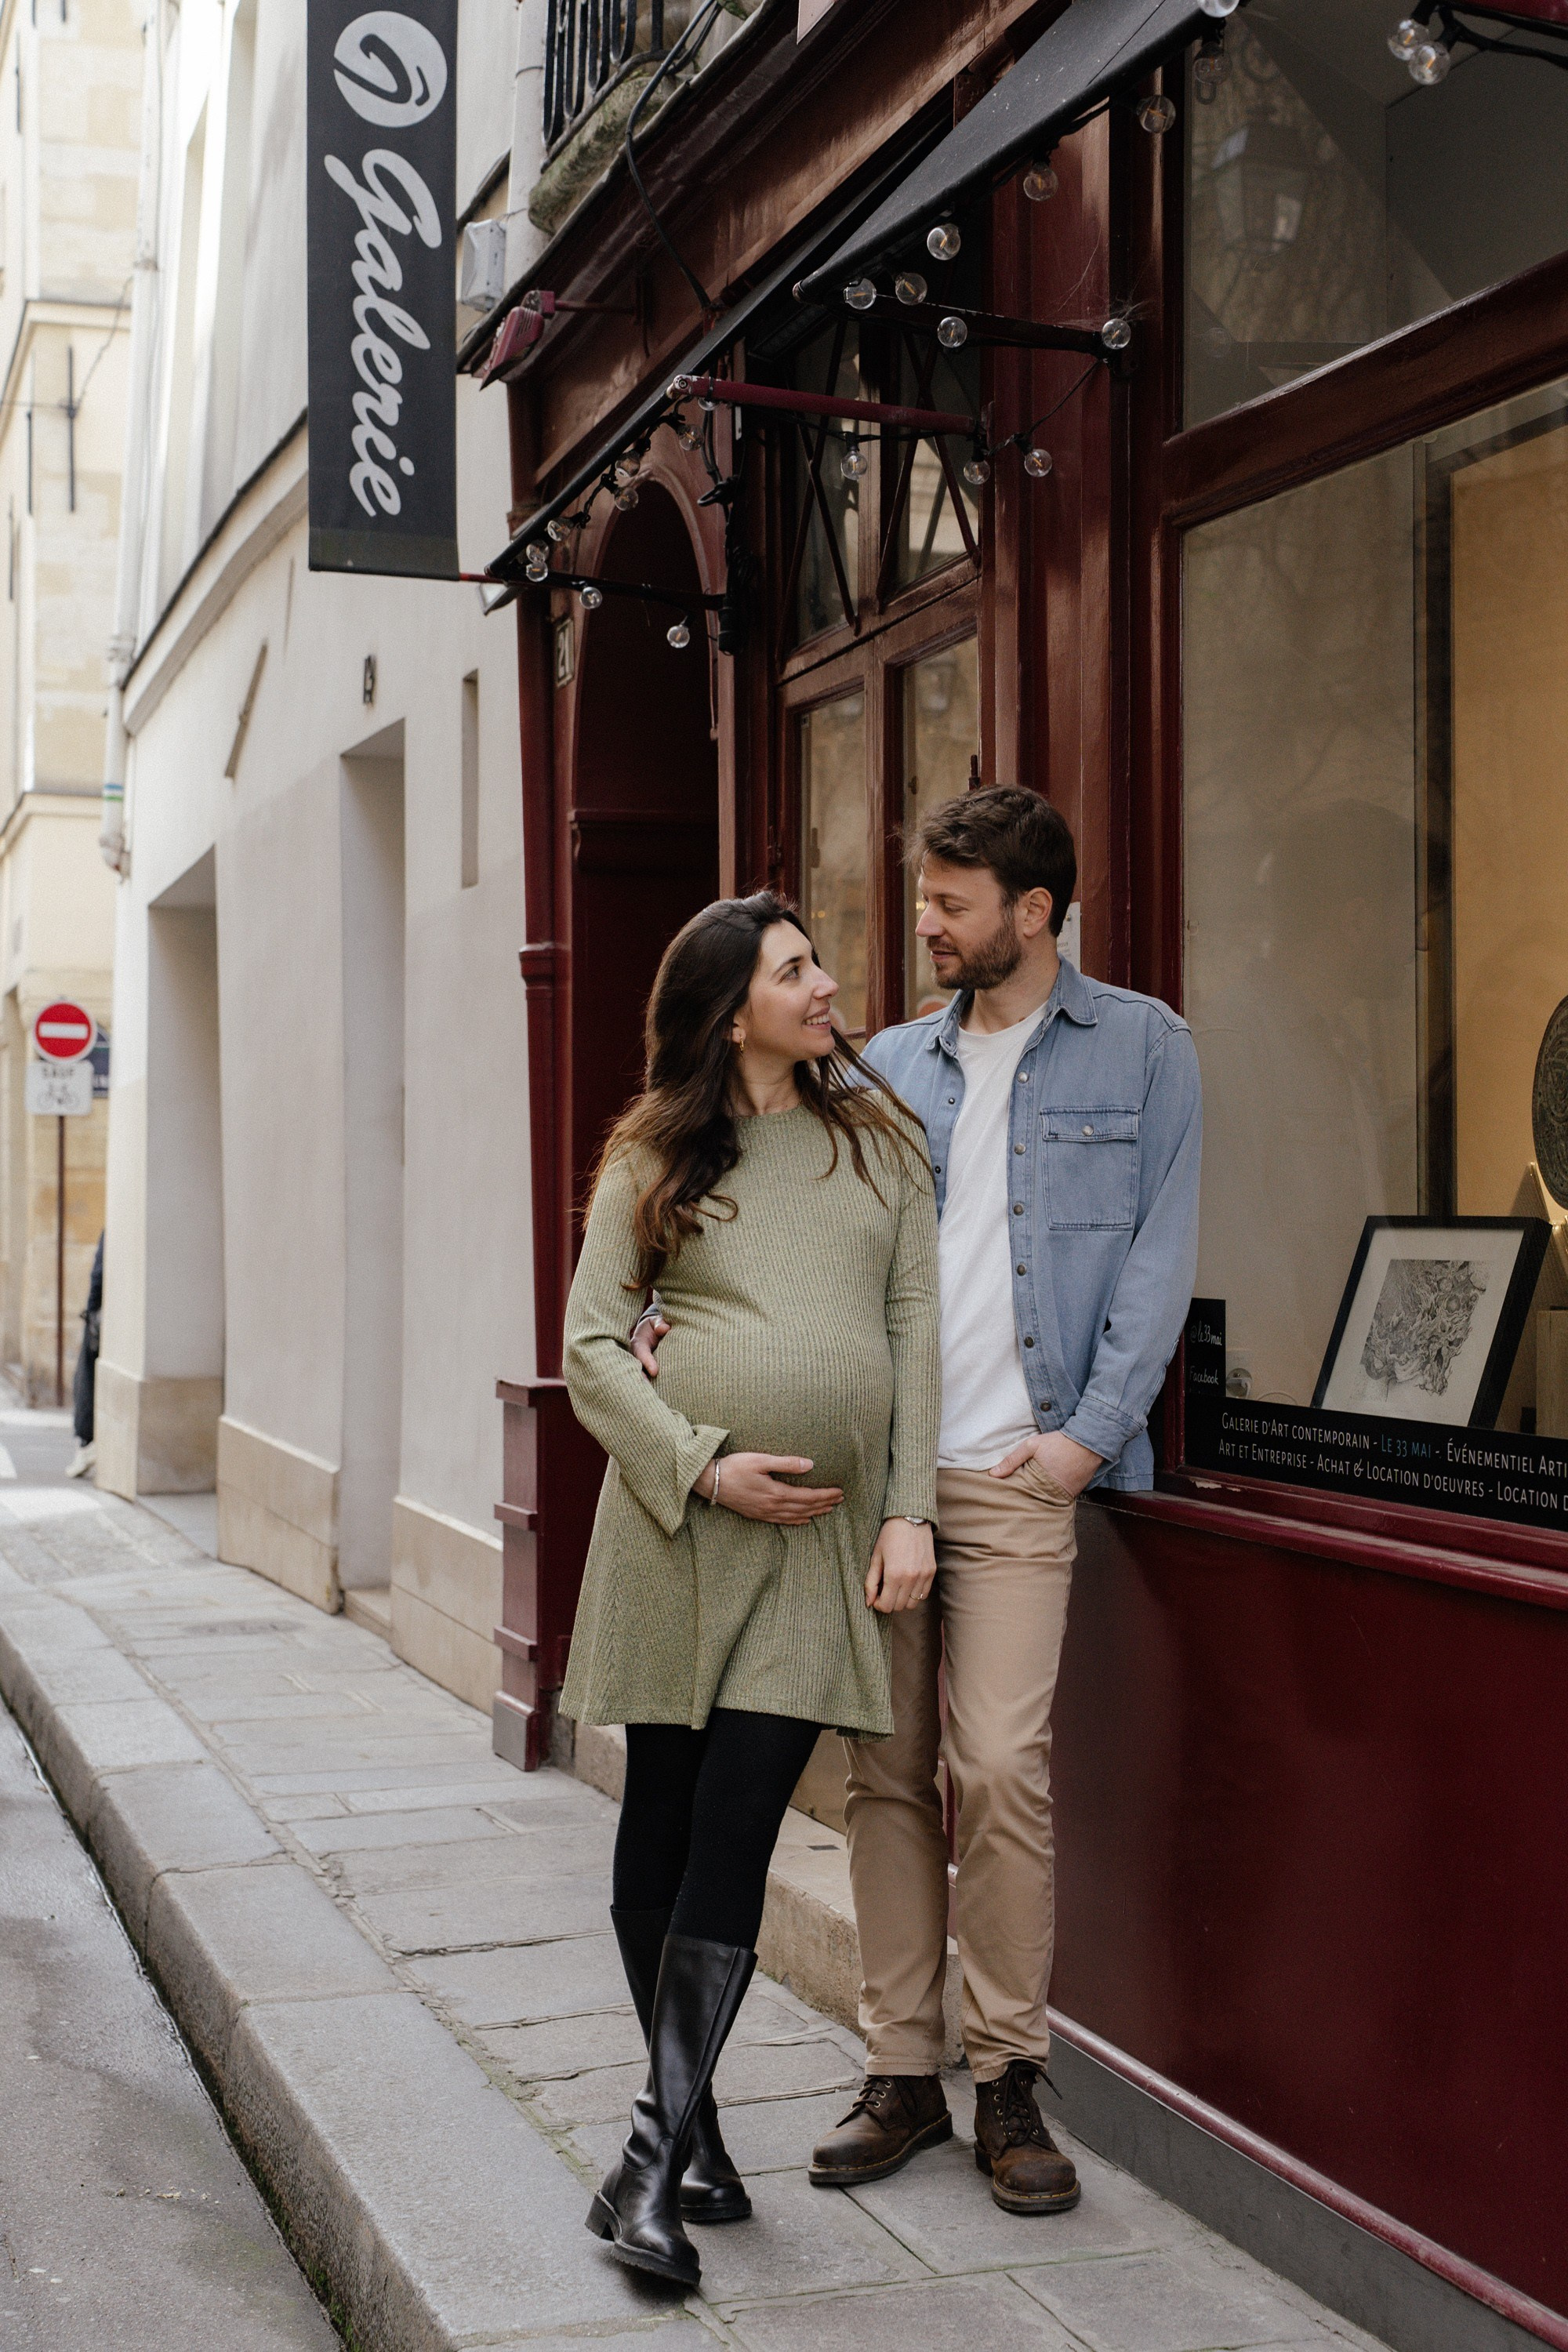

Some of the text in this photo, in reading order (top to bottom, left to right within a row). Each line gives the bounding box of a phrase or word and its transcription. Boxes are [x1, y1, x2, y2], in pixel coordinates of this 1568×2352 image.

[324, 148, 443, 517] Galerie
[557, 624, 571, 680] 21
[1190, 1320, 1222, 1346] @le33mai
[1189, 1366, 1219, 1385] Facebook
[1221, 1412, 1259, 1434] GALERIE
[1261, 1419, 1289, 1437] D'ART
[1292, 1425, 1370, 1450] CONTEMPORAIN
[1381, 1434, 1392, 1453] LE
[1396, 1439, 1408, 1457] 33
[1411, 1442, 1431, 1459] MAI
[1447, 1438, 1535, 1474] ÉVÉNEMENTIEL
[1218, 1439, 1236, 1457] ART
[1239, 1445, 1249, 1458] ET
[1252, 1444, 1307, 1468] ENTREPRISE
[1317, 1454, 1350, 1475] ACHAT
[1353, 1458, 1363, 1477] &
[1367, 1461, 1419, 1487] LOCATION
[1424, 1473, 1484, 1497] D'OEUVRES
[1497, 1481, 1558, 1509] LOCATION
